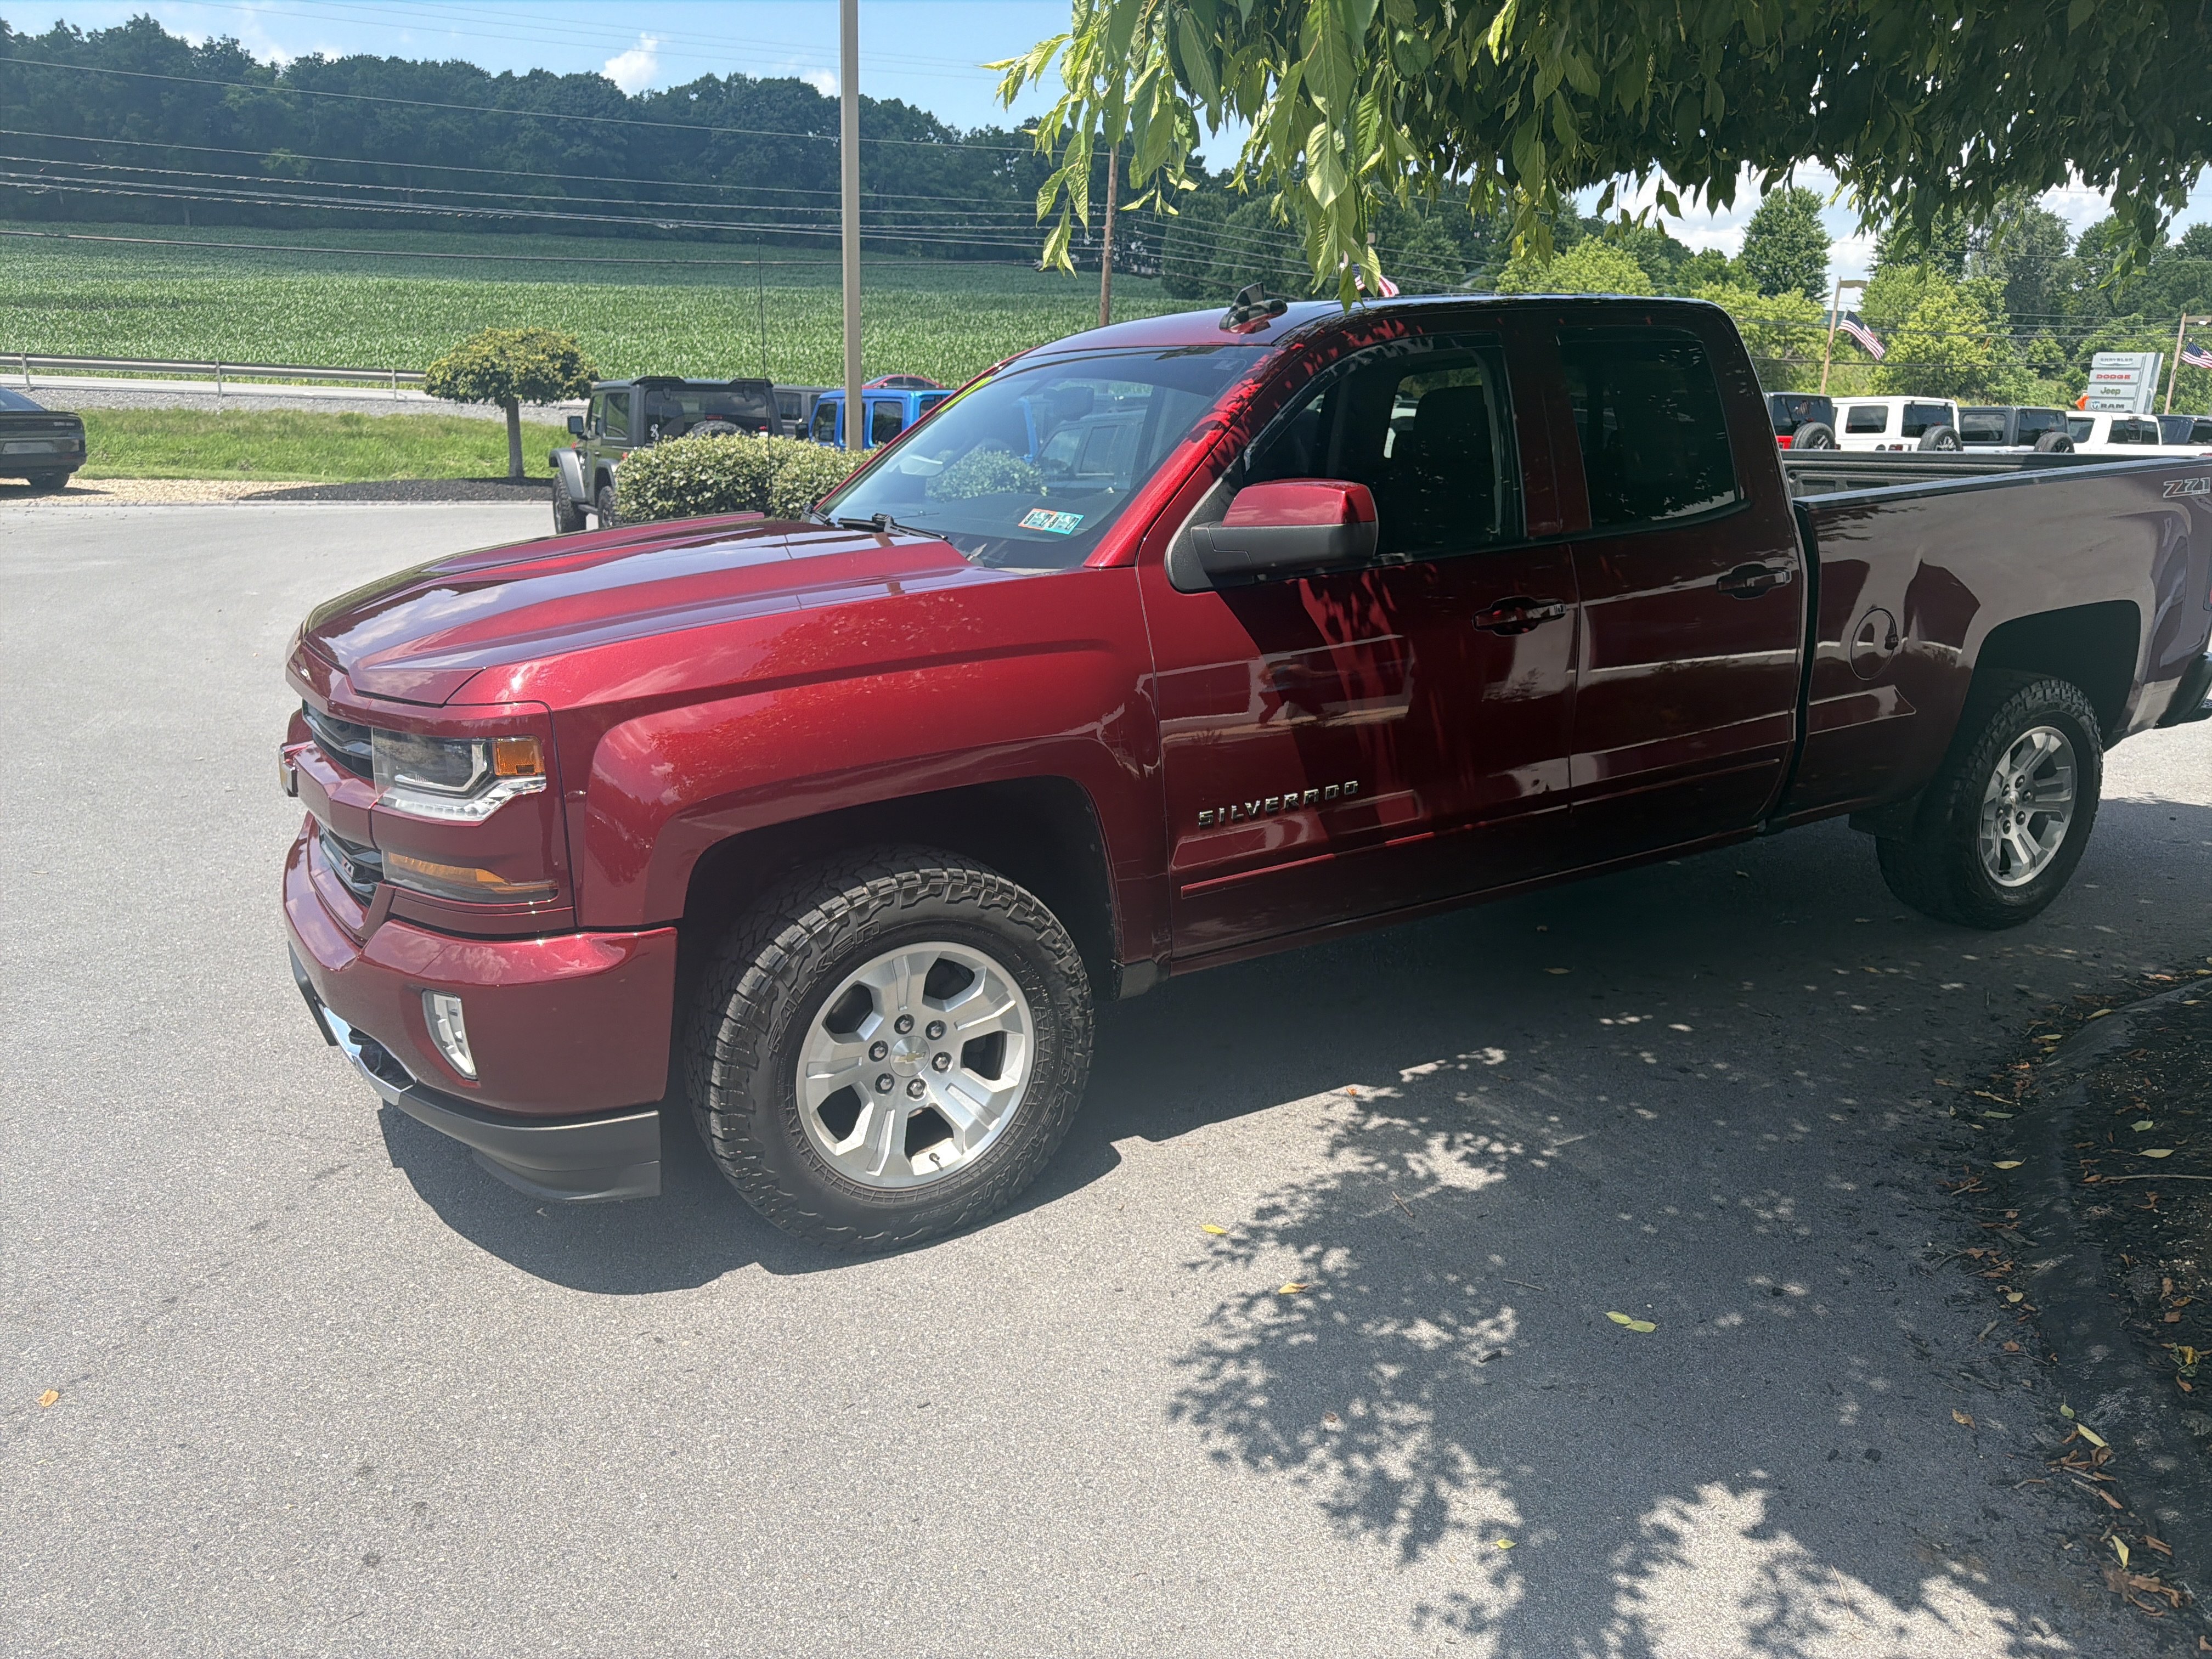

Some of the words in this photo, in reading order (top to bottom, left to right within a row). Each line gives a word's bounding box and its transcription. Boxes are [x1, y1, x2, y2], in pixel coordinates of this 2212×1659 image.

[2100, 387, 2121, 396] Jeep
[2163, 477, 2210, 498] Z71
[1198, 780, 1359, 826] SILVERADO
[1014, 1002, 1075, 1170] WILDPEAK
